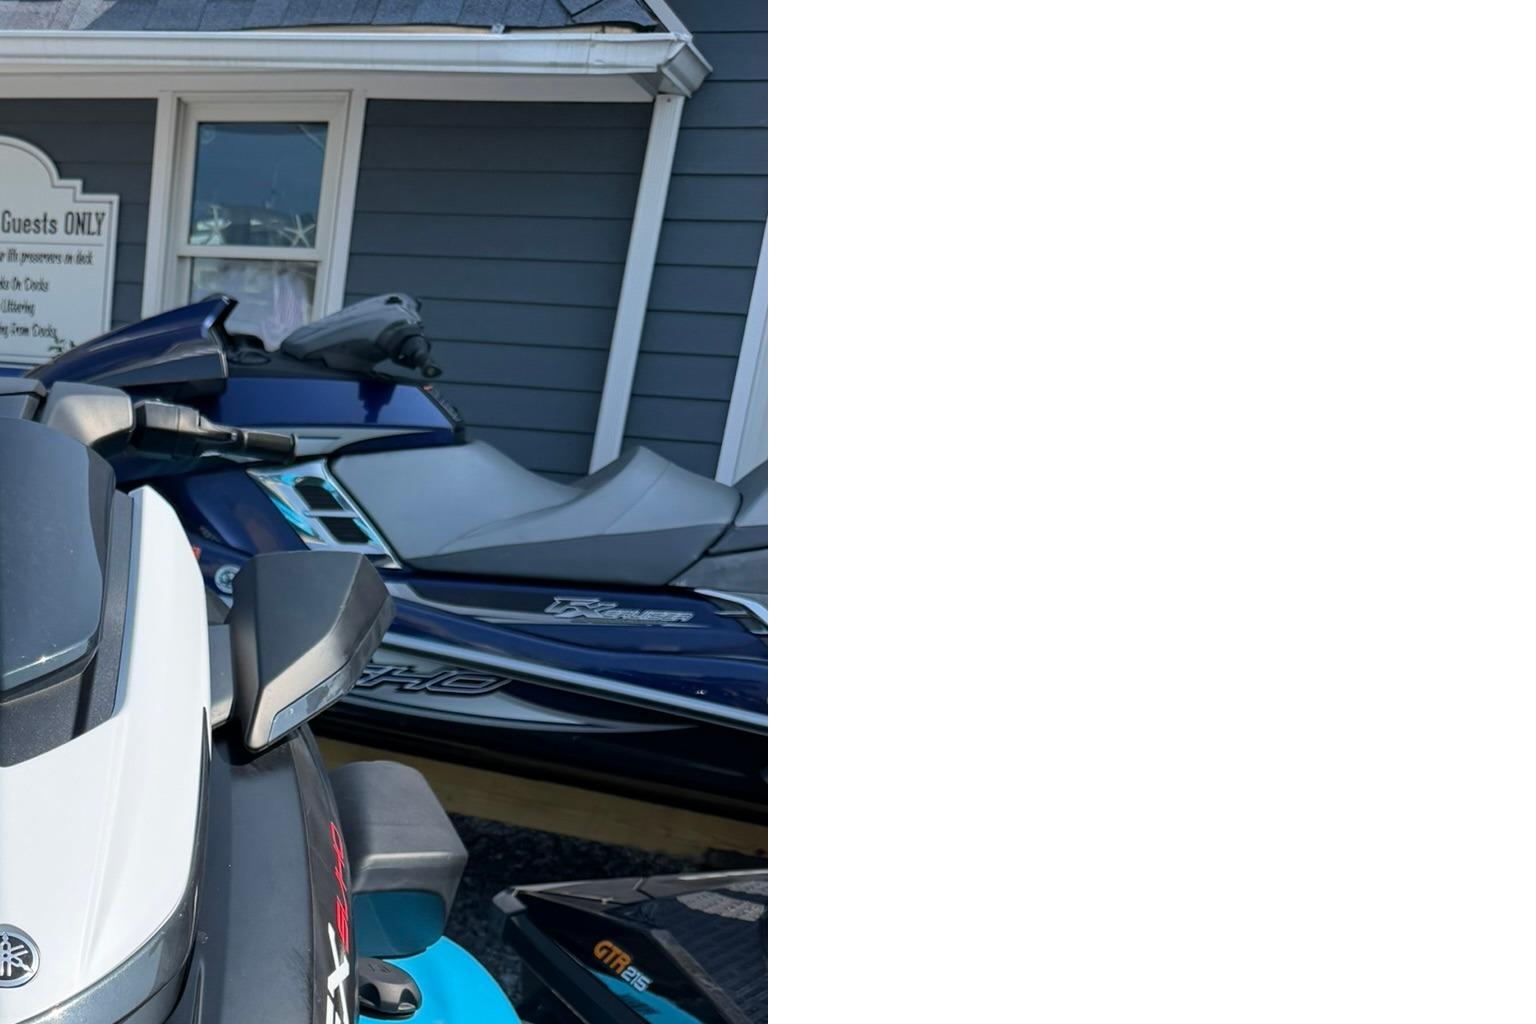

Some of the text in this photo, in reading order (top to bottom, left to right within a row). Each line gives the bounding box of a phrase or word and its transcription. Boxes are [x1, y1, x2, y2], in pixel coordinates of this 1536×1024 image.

[1, 210, 57, 235] Guests
[65, 211, 106, 236] ONLY
[593, 939, 653, 992] GTR 215
